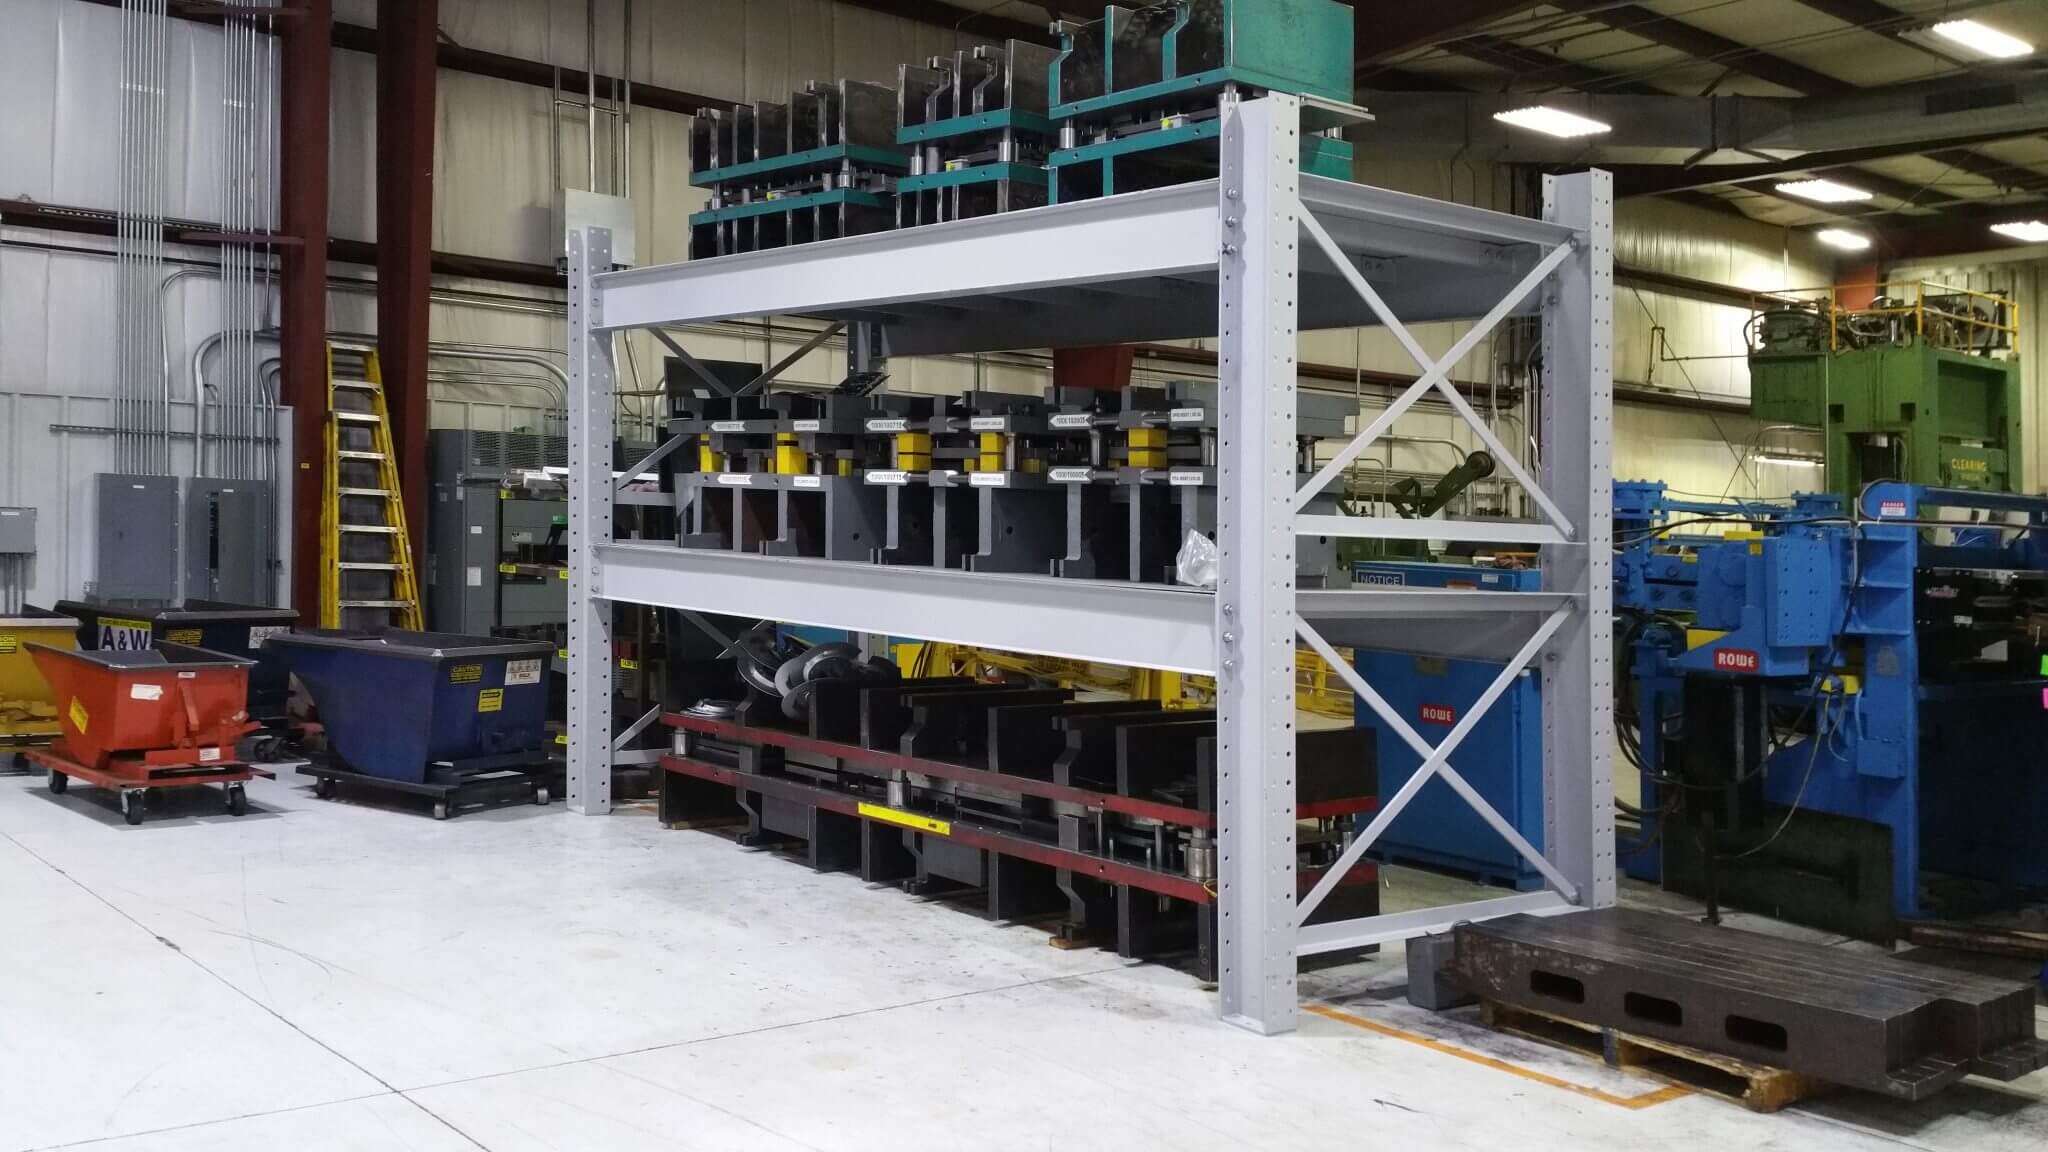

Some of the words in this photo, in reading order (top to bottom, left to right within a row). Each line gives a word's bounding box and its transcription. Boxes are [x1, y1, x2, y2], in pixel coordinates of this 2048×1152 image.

[1361, 575, 1400, 585] NOTICE
[1718, 652, 1755, 668] ROWE
[1423, 707, 1453, 722] ROWE
